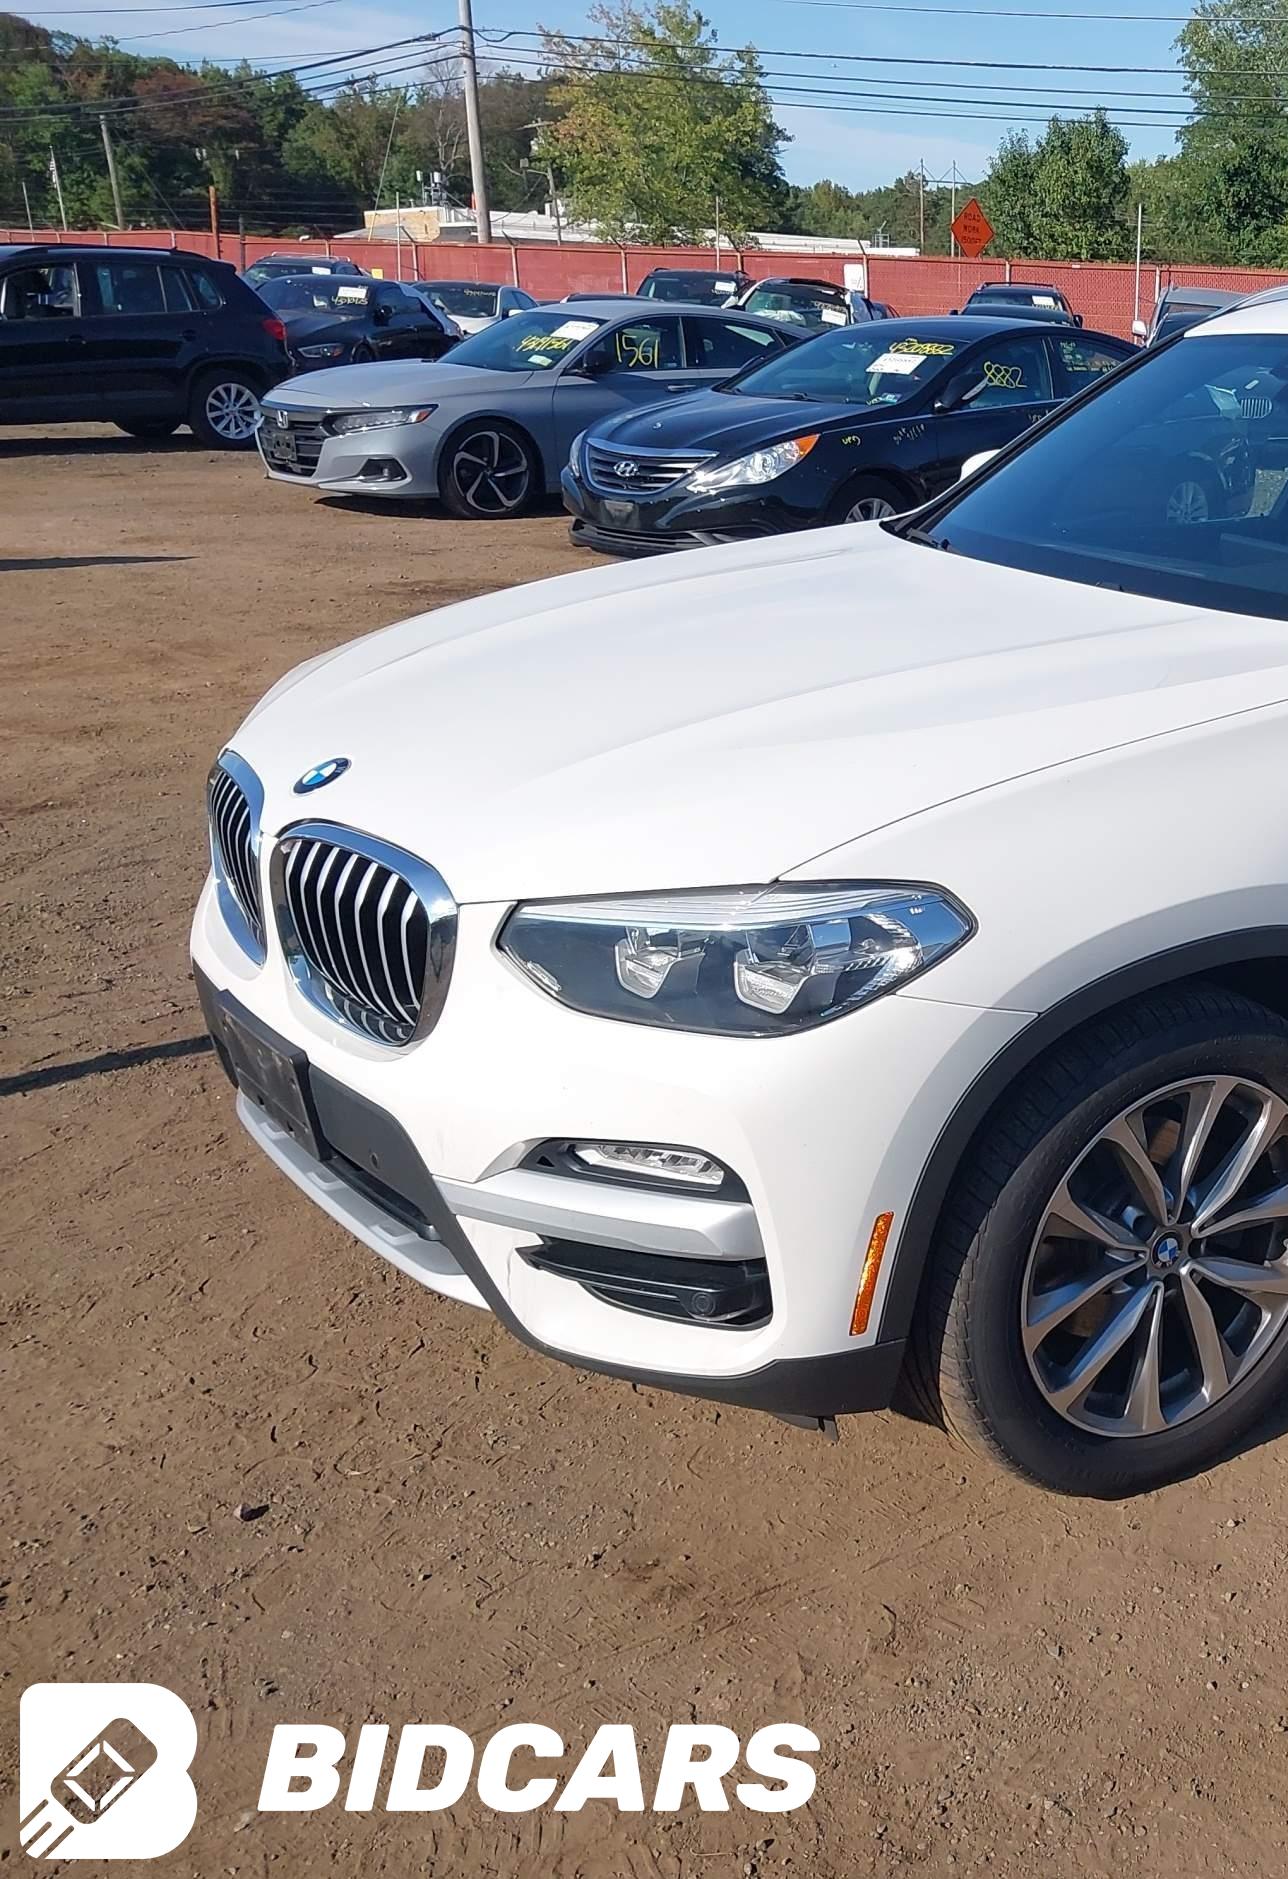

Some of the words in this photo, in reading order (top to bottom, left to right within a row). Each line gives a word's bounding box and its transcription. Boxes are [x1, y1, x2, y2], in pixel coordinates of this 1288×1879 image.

[963, 212, 981, 223] ROAD
[615, 332, 659, 369] 1561
[983, 361, 1028, 389] 8882
